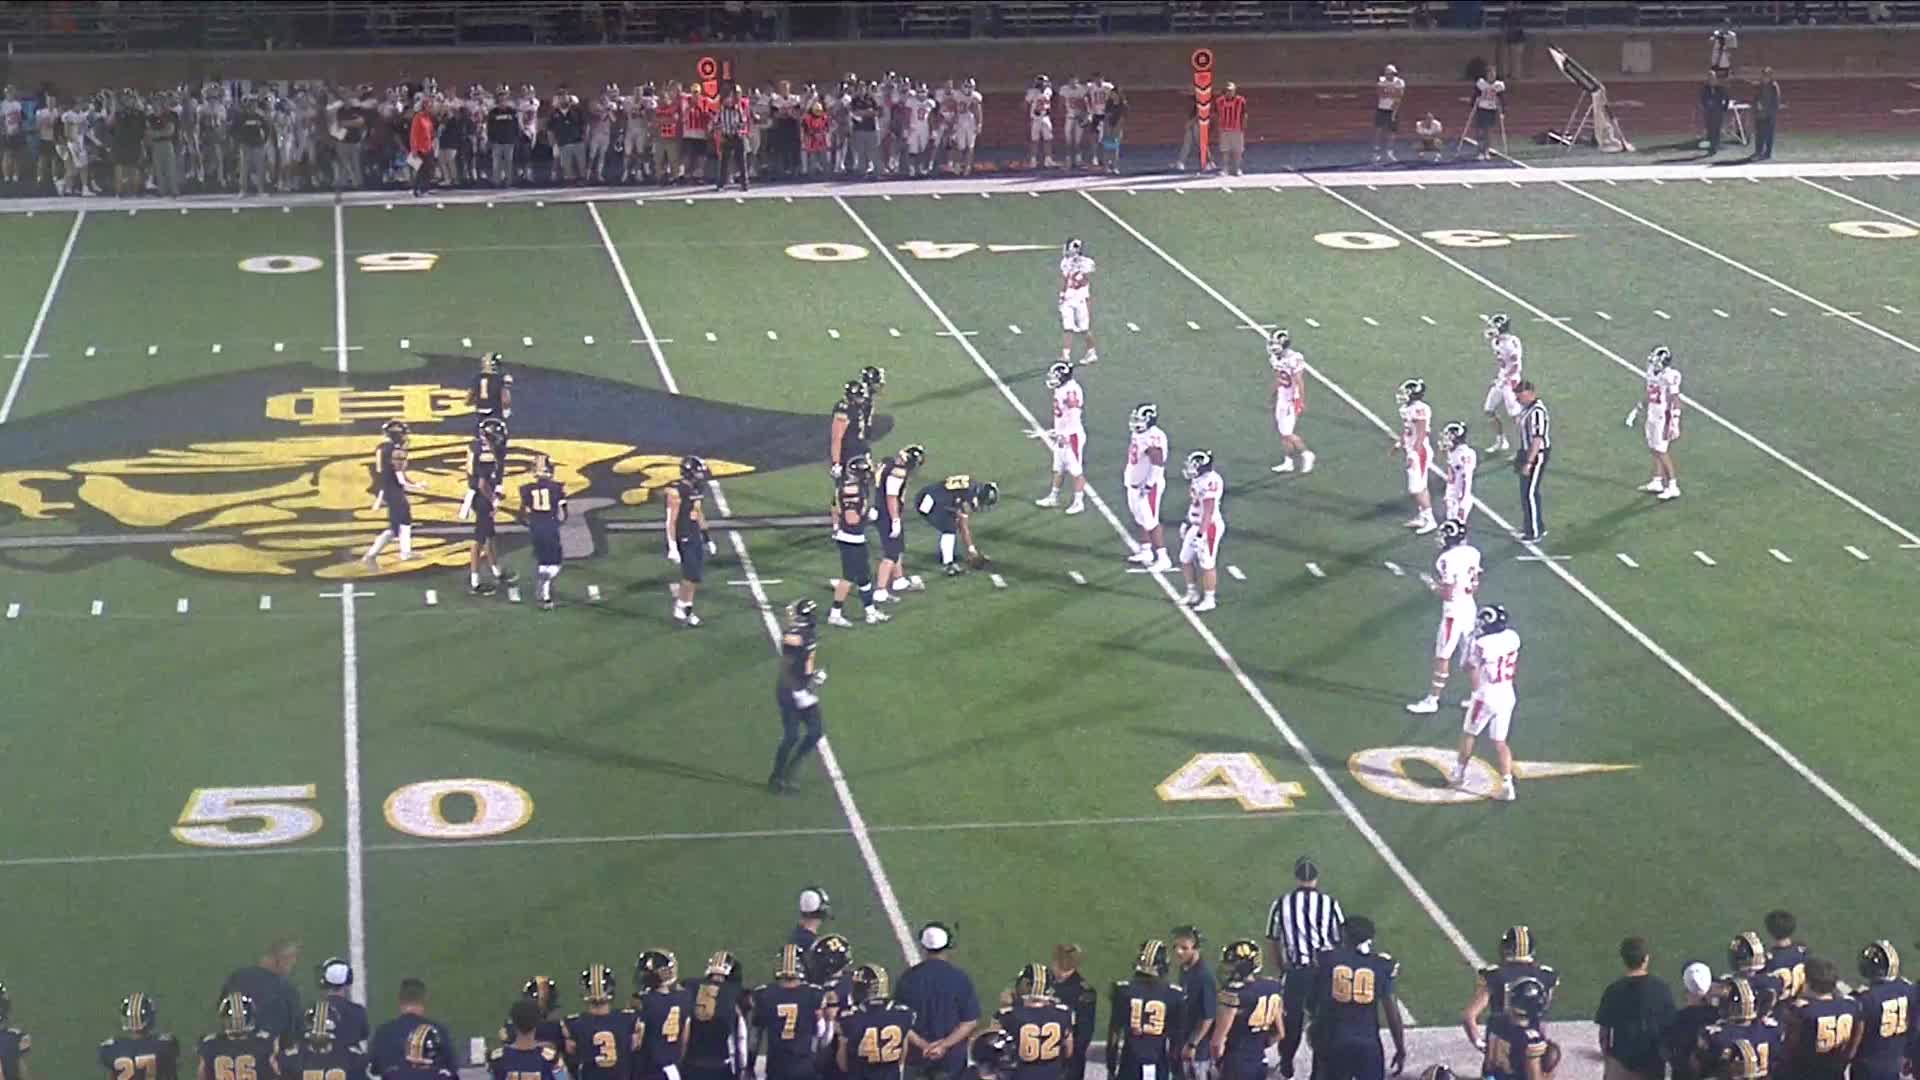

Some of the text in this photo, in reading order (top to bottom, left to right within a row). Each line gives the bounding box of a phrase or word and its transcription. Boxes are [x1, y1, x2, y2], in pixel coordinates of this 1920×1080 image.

[530, 488, 552, 511] 11
[1332, 965, 1376, 1004] 60
[661, 1005, 681, 1042] 4
[777, 1003, 799, 1039] 7
[1129, 998, 1167, 1036] 13
[1879, 996, 1908, 1038] 51
[592, 1031, 618, 1067] 3
[857, 1025, 903, 1063] 42
[1018, 1022, 1061, 1062] 62
[113, 1054, 156, 1080] 27
